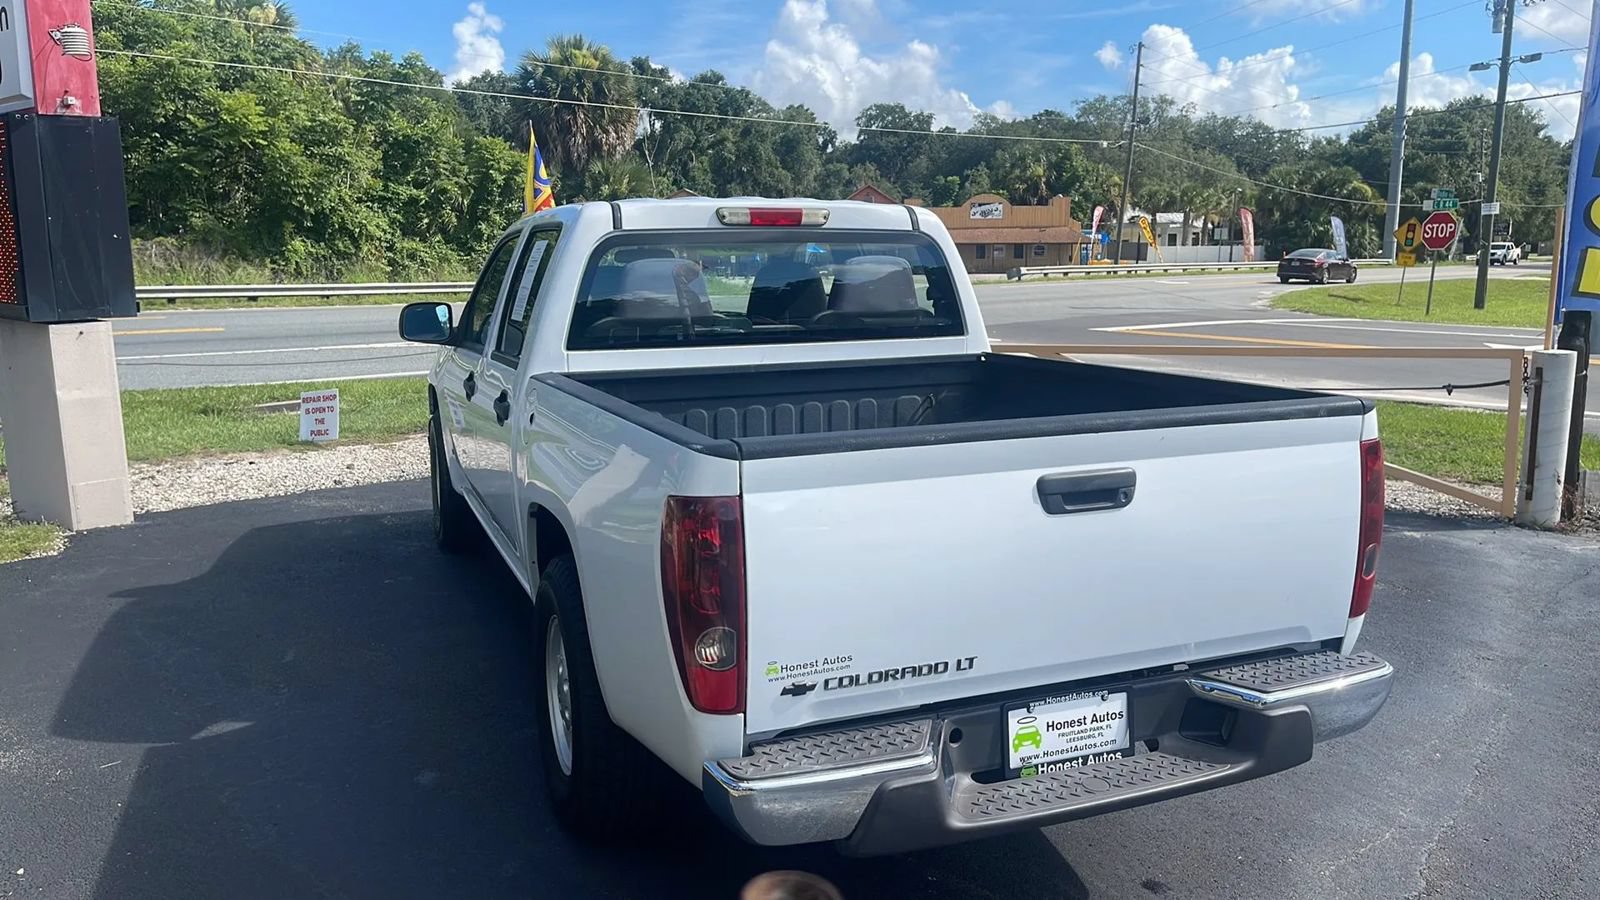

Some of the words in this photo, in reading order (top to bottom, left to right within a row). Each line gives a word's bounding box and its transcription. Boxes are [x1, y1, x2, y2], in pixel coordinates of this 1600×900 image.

[1424, 223, 1455, 238] STOP
[302, 395, 321, 403] REPAIR
[322, 394, 337, 402] SHOP
[310, 429, 329, 437] PUBLIC
[780, 659, 819, 673] Honest
[822, 654, 853, 666] Autos
[767, 664, 851, 683] www.HonestAutos.com
[824, 661, 949, 691] COLORADO
[956, 656, 978, 672] LT
[1029, 690, 1109, 707] www.HonestAutos.com
[1046, 715, 1087, 732] Honest
[1090, 710, 1124, 722] Autos
[1058, 728, 1089, 739] FRUITLAND
[1089, 725, 1105, 733] PARK,
[1066, 734, 1096, 744] LEESBURG,
[1019, 738, 1117, 763] www.HonestAutos.com
[1038, 757, 1083, 775] Honest
[1087, 751, 1123, 766] Autos
